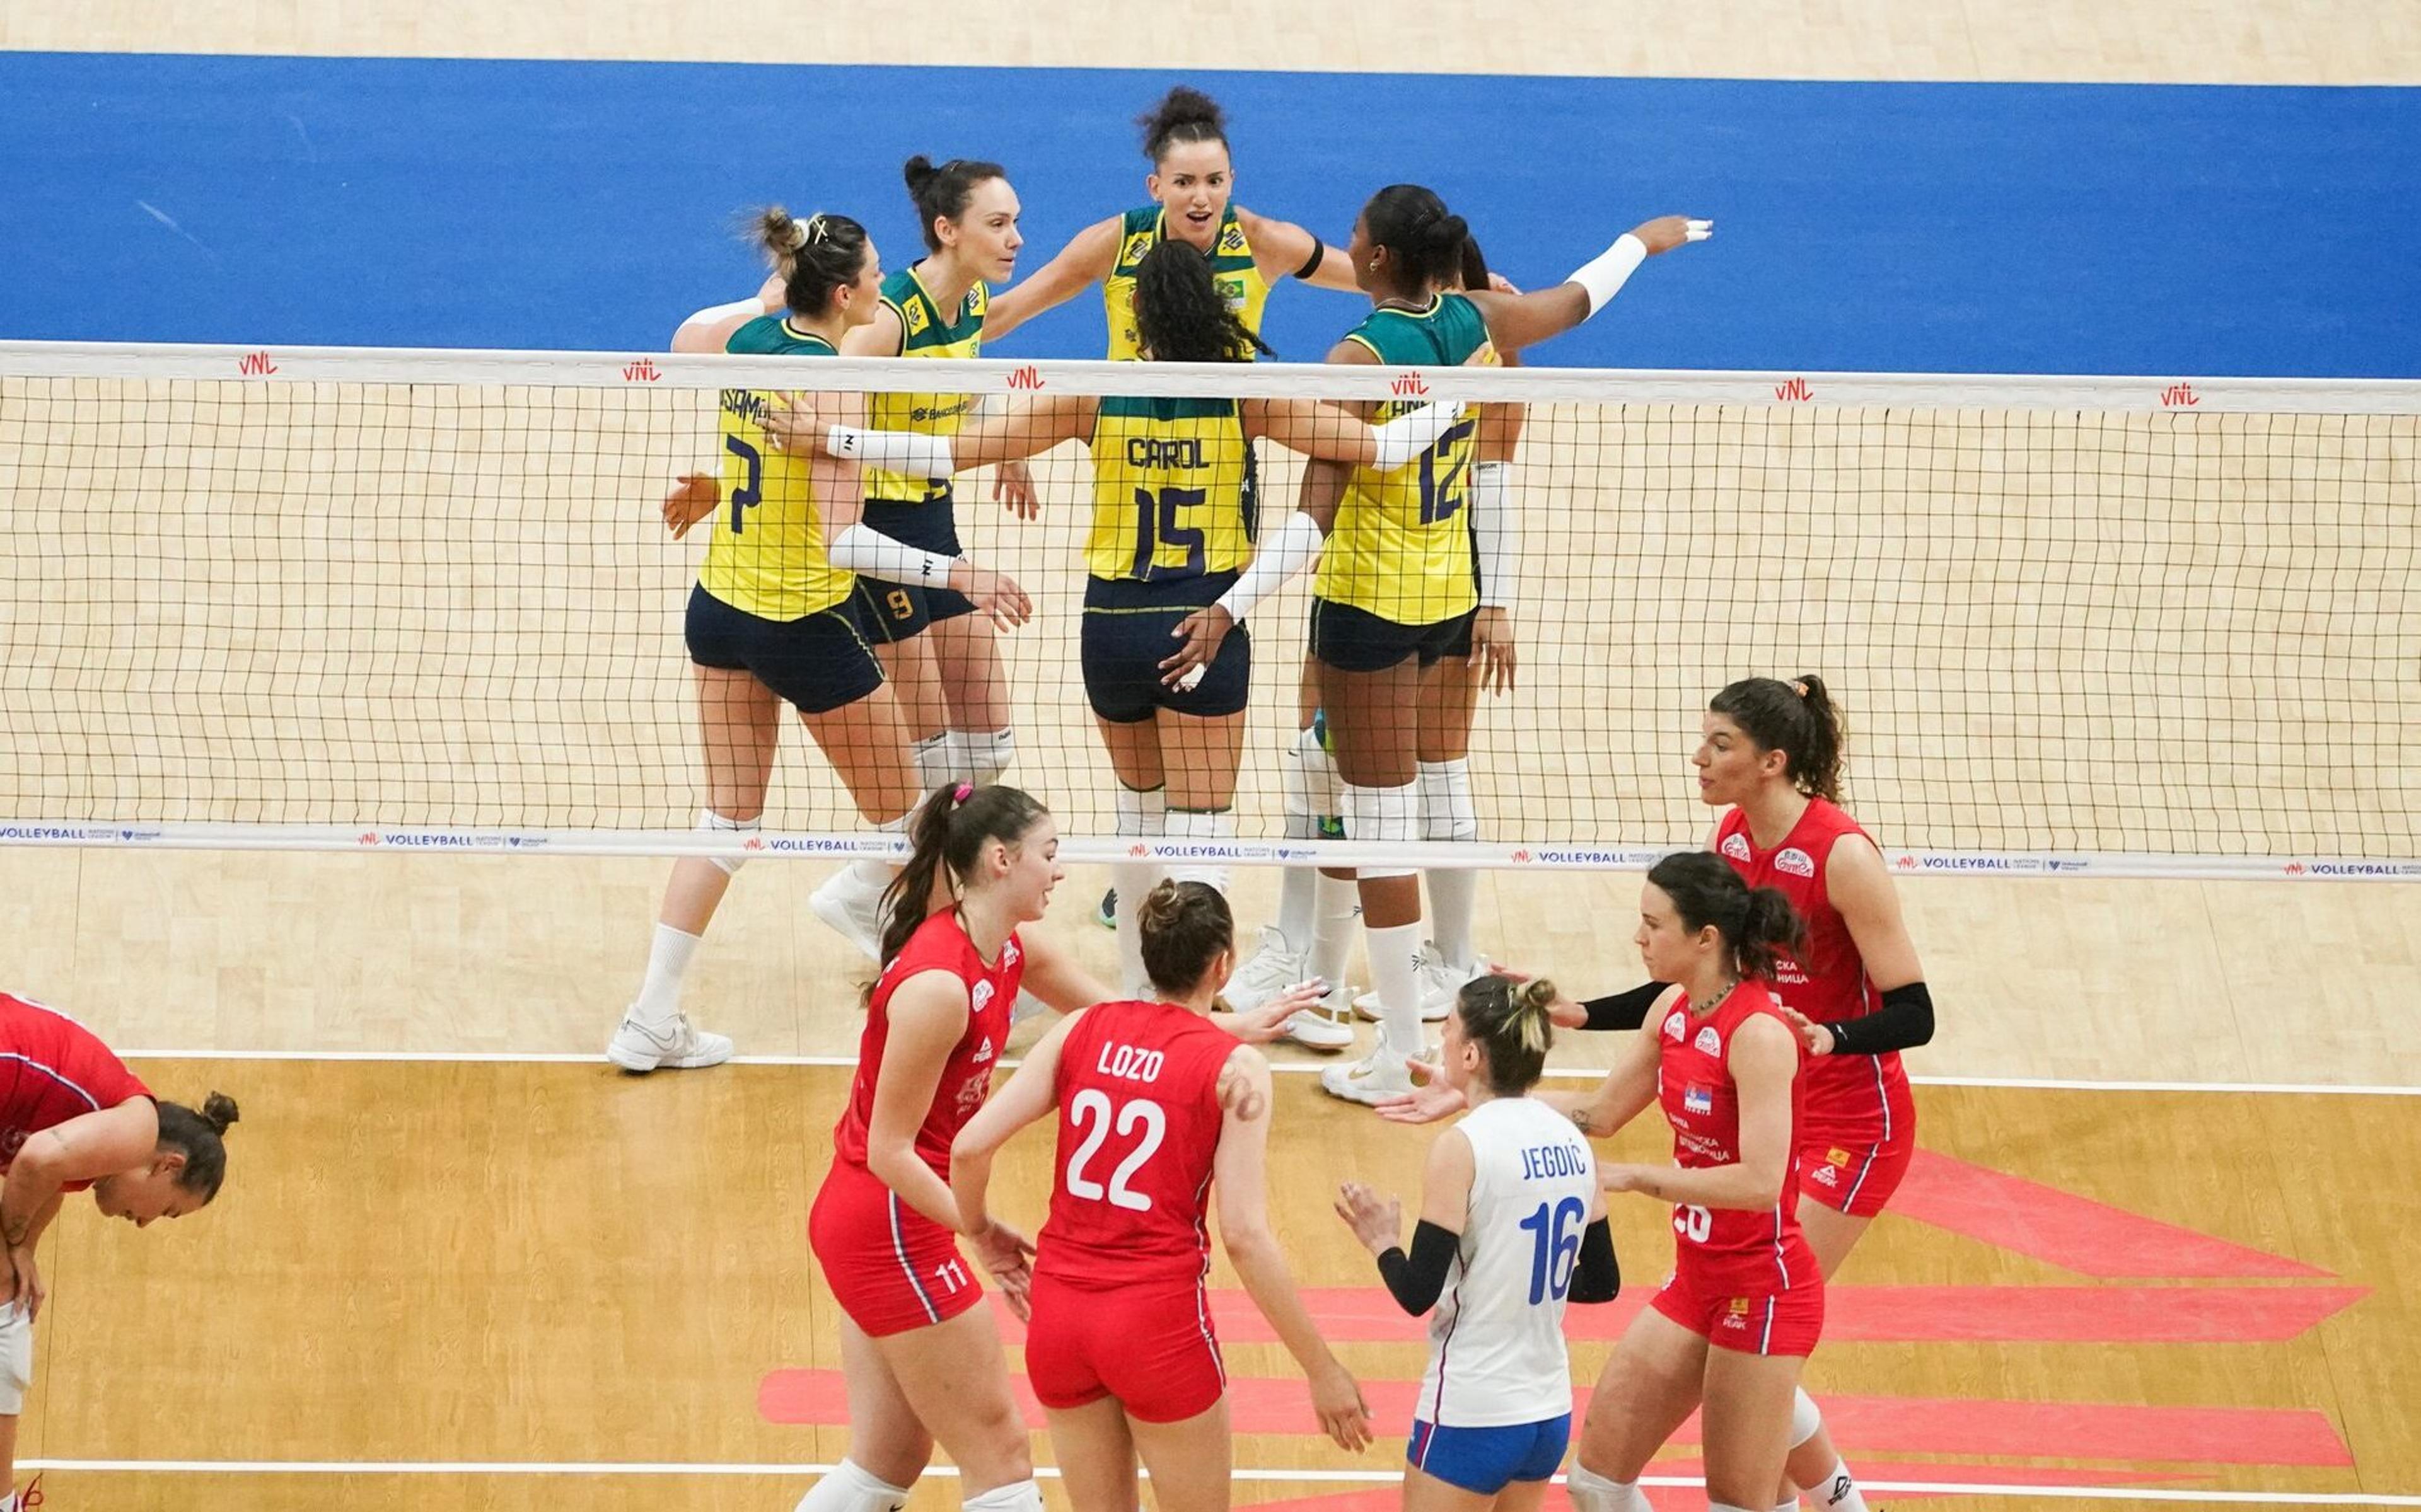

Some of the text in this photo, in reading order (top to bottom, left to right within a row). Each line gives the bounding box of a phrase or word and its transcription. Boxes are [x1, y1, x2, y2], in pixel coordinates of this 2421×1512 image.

[240, 351, 278, 375] VNL
[624, 360, 660, 383] VNL
[1007, 365, 1045, 390] VNL
[1391, 371, 1429, 396] VNL
[1775, 378, 1813, 402] VNL
[2161, 382, 2199, 407] VNL
[1127, 437, 1210, 470] CAROL
[1419, 418, 1476, 525] 12
[1129, 487, 1207, 582] 15
[385, 834, 473, 846] VOLLEYBALL
[770, 840, 858, 851] VOLLEYBALL
[1154, 846, 1242, 858] VOLLEYBALL
[1539, 851, 1625, 863] VOLLEYBALL
[1923, 858, 2011, 869] VOLLEYBALL
[2311, 864, 2400, 875] VOLLEYBALL
[1096, 1041, 1164, 1083] LOZO
[1066, 1088, 1166, 1212] 22
[1521, 1137, 1586, 1180] JEGDIĆ
[1519, 1196, 1584, 1306] 16
[935, 1258, 968, 1295] 11
